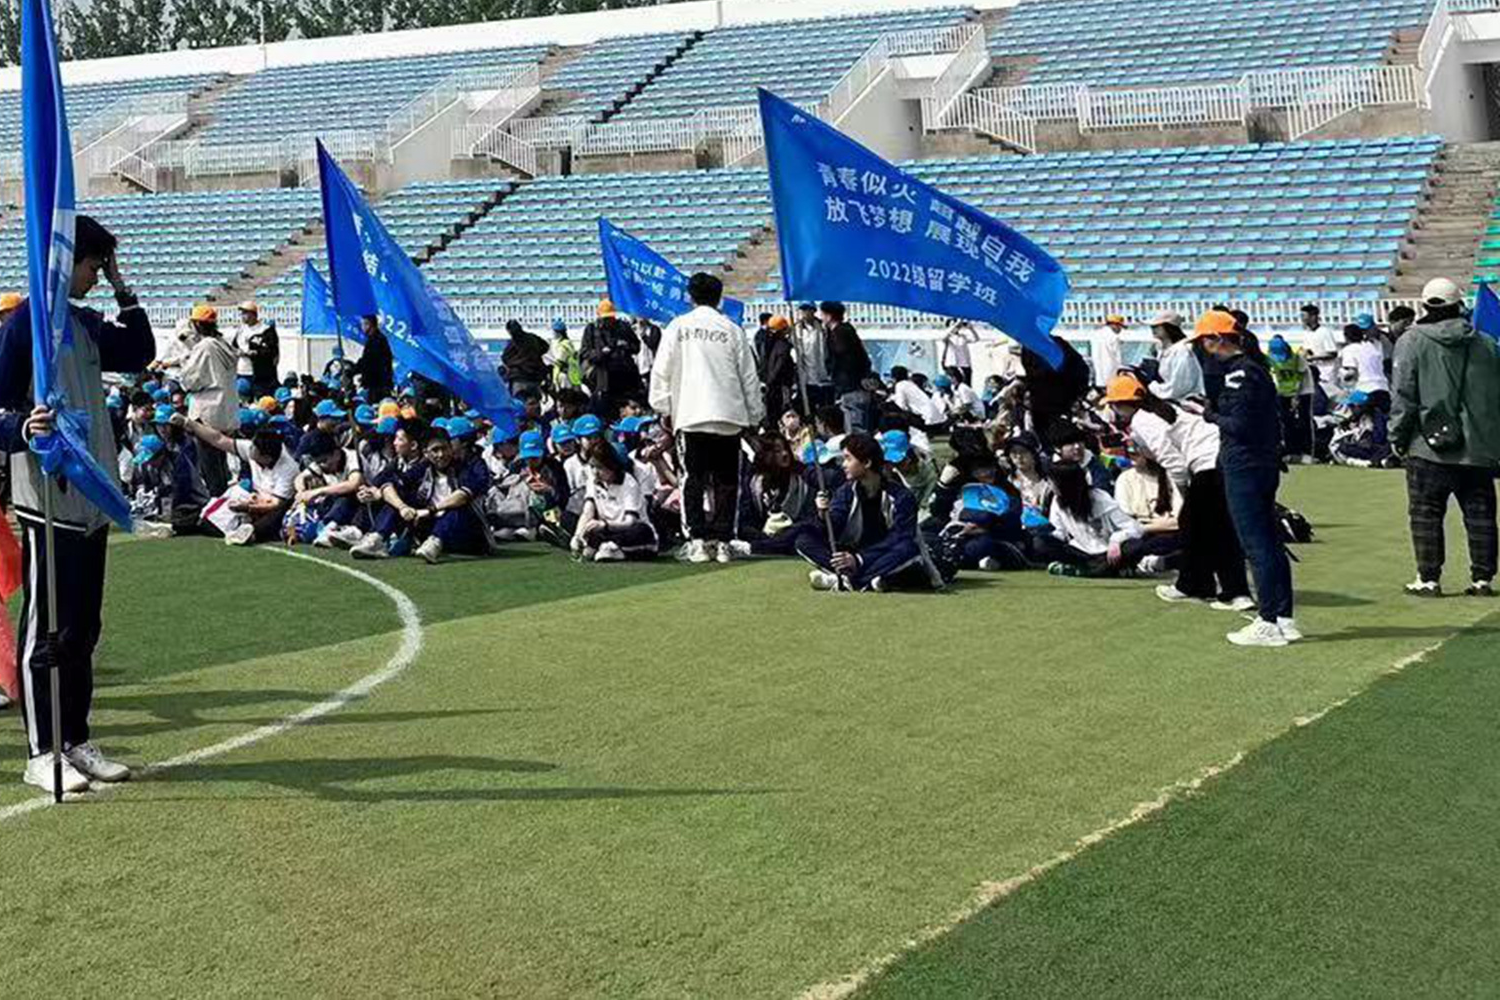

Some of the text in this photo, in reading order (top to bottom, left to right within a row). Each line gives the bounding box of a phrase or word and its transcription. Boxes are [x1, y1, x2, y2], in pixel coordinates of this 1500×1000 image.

[817, 162, 917, 205] 青春似火
[824, 195, 914, 234] 放飞梦想
[865, 257, 999, 307] 2022级留学班
